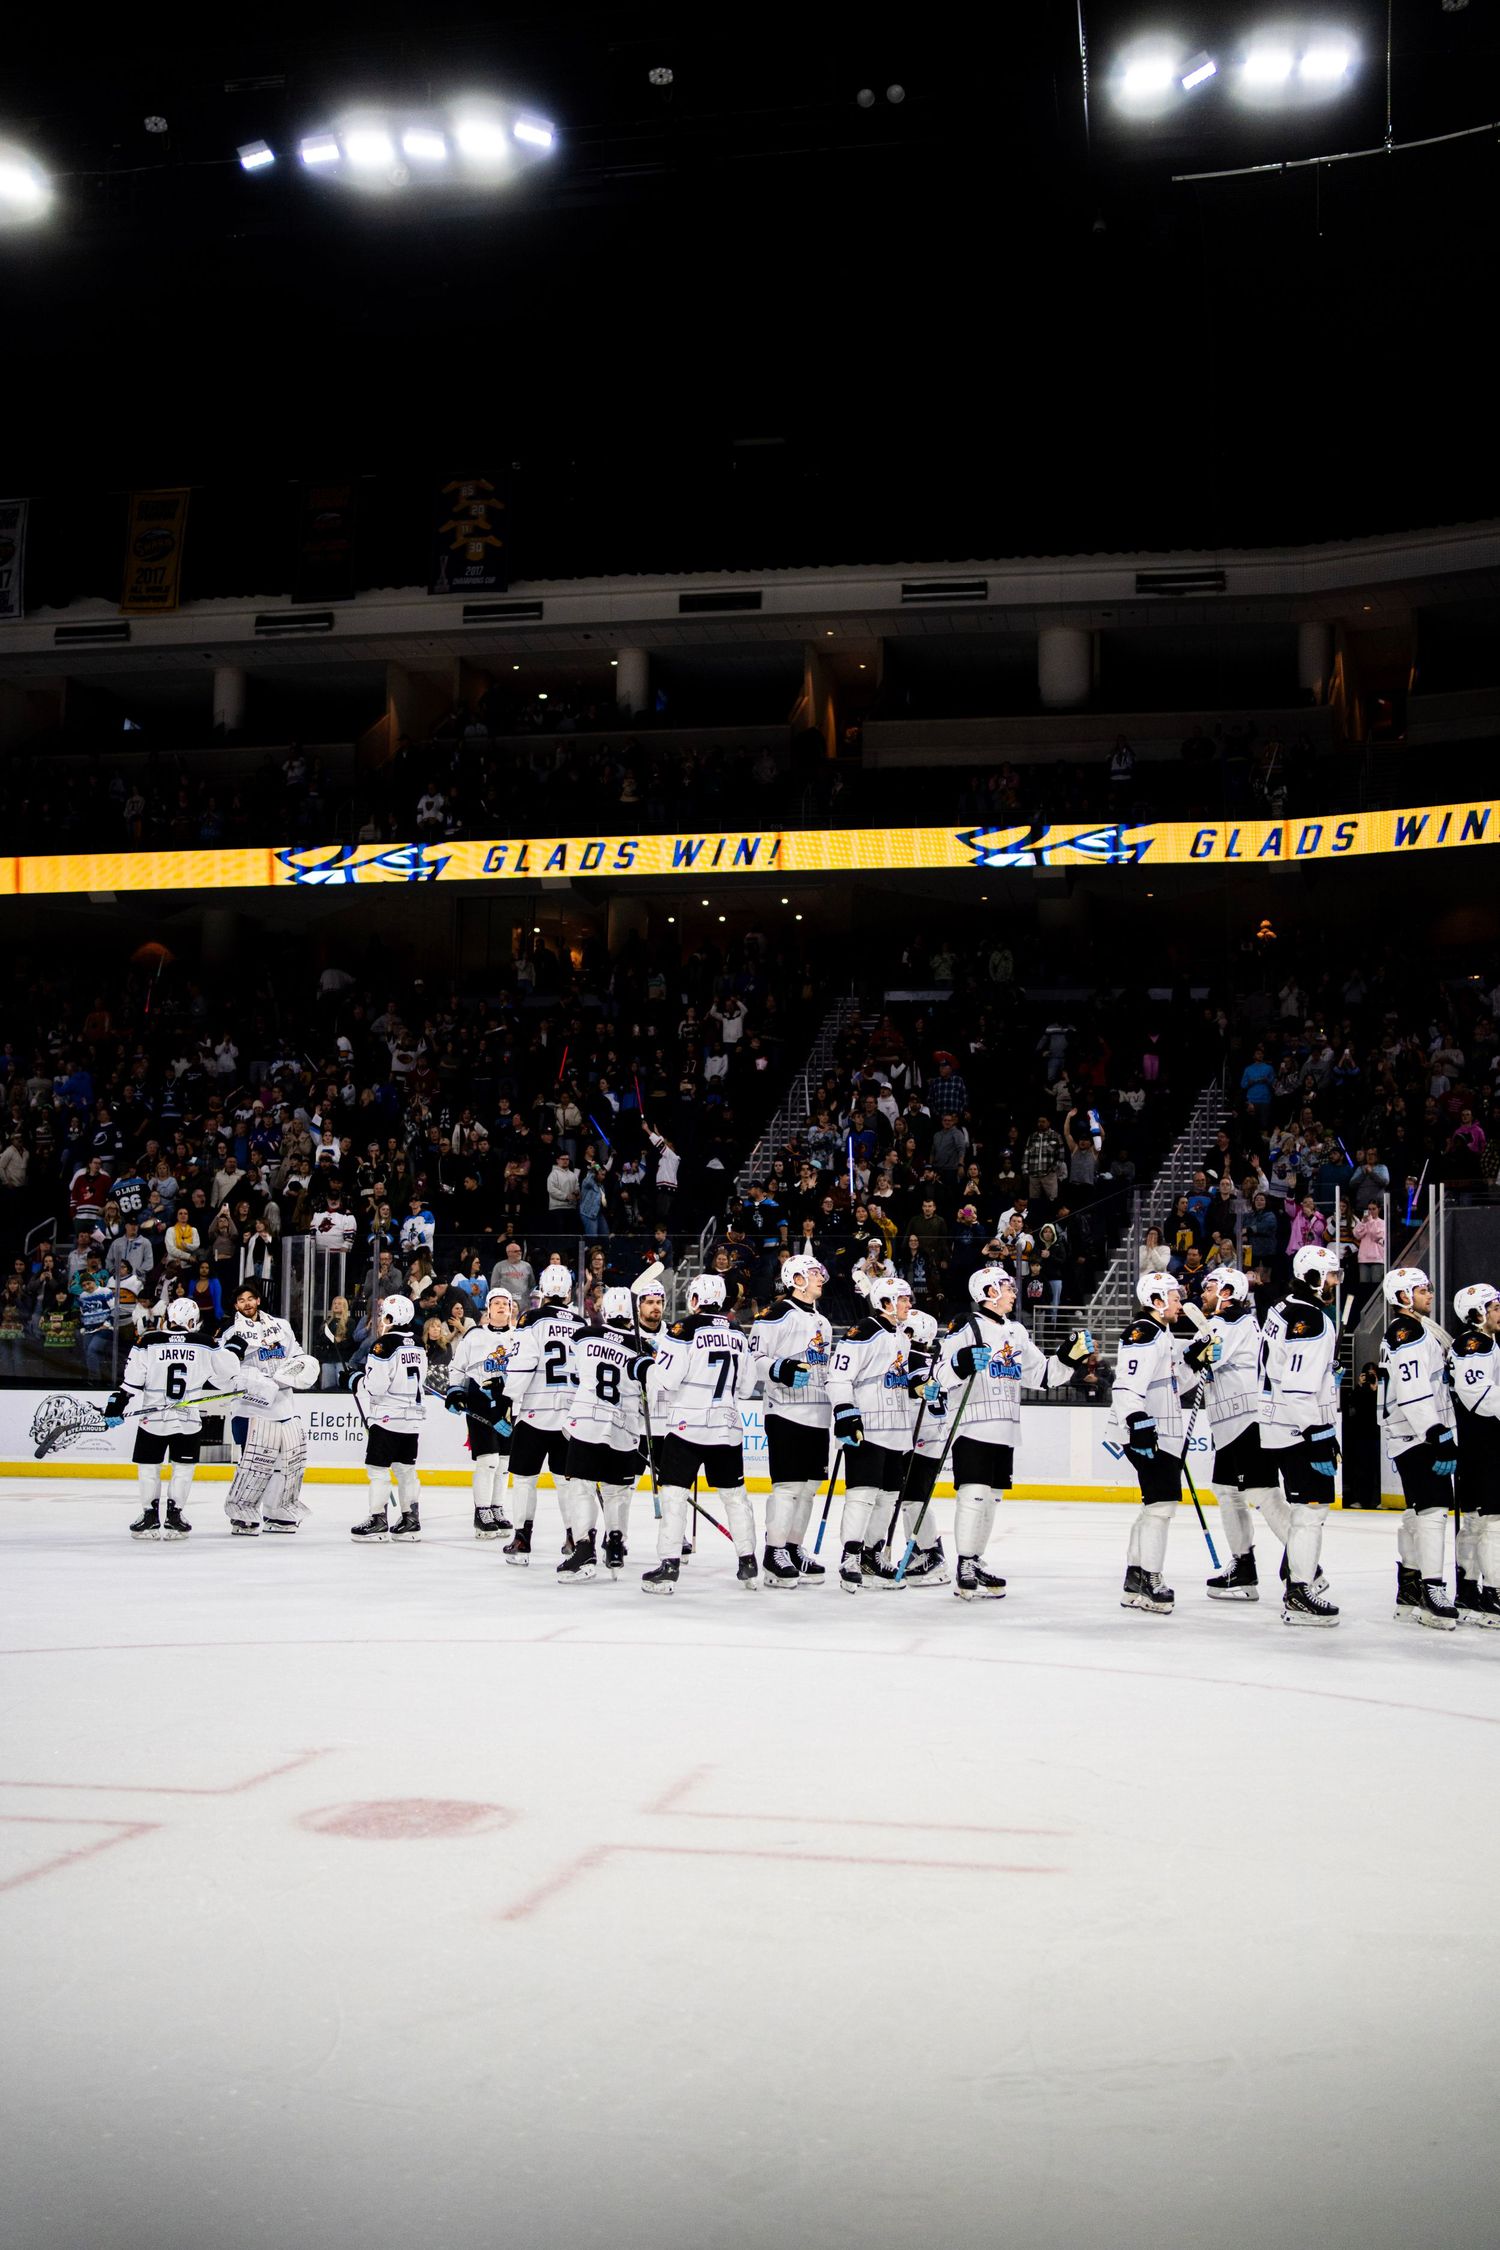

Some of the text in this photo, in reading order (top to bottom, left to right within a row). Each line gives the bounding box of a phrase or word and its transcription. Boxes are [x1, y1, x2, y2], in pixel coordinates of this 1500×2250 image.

[135, 567, 167, 584] 2017
[465, 566, 485, 576] 2017
[1189, 808, 1492, 858] GLADS WIN
[482, 837, 781, 873] GLADS WIN!
[122, 1184, 140, 1195] LANE
[120, 1194, 142, 1213] 66
[159, 1349, 195, 1361] JARVIS
[401, 1352, 421, 1364] BURNS
[587, 1344, 630, 1368] CONROY
[658, 1351, 674, 1370] 71
[834, 1354, 850, 1371] 13
[1290, 1353, 1303, 1373] 11
[365, 1366, 373, 1379] 7
[707, 1350, 739, 1400] 71
[1128, 1360, 1138, 1375] 9
[1399, 1360, 1419, 1382] 37
[166, 1362, 188, 1402] 6
[407, 1366, 422, 1405] 7
[595, 1361, 621, 1406] 8
[66, 1426, 106, 1436] STEAKHOUSE
[307, 1429, 364, 1442] tems Inc
[254, 1456, 276, 1465] BAUER
